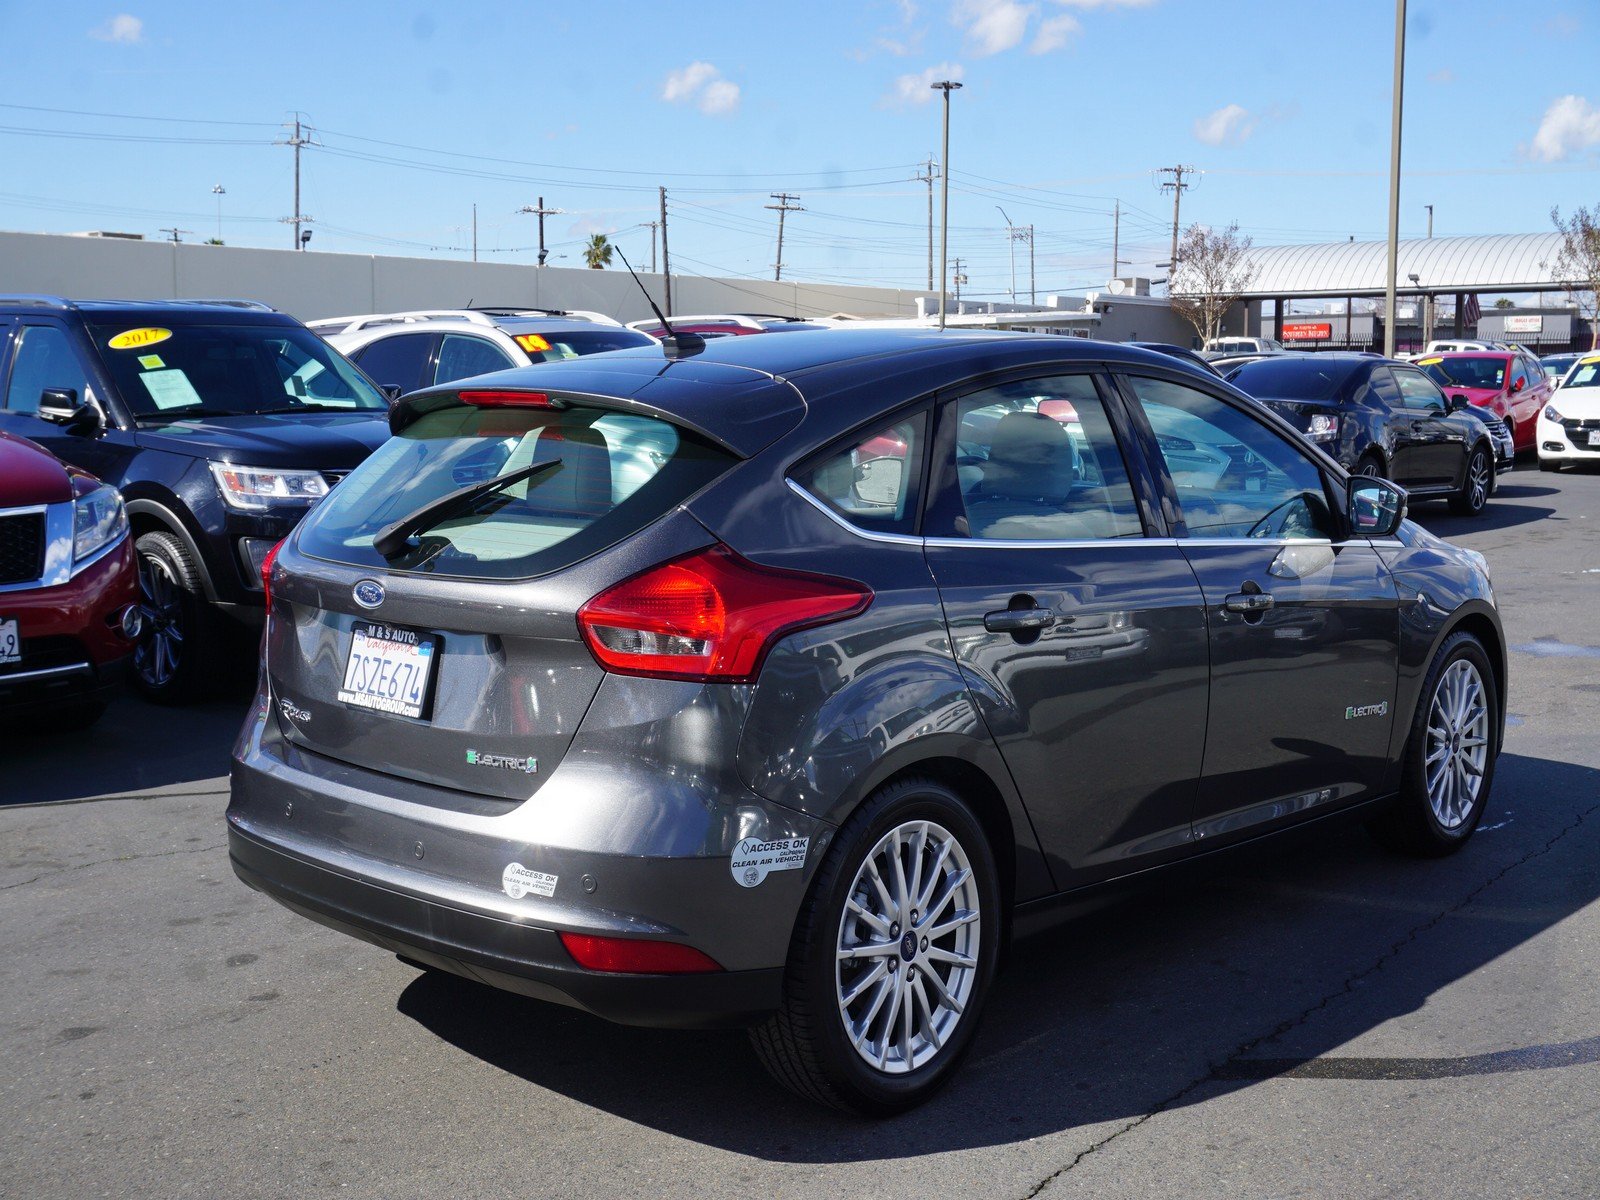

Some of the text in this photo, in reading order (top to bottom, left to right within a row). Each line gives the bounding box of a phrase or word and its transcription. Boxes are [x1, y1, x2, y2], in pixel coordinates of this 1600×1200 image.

[123, 329, 159, 347] 2017
[367, 625, 376, 638] M
[376, 626, 383, 638] &
[384, 628, 391, 639] S
[392, 629, 416, 644] AUTO
[366, 637, 418, 656] California
[350, 653, 420, 703] 7SZE674
[338, 690, 420, 718] www.MSAUTOGROUP.com
[1345, 703, 1384, 719] ELECTRIC
[466, 749, 527, 771] ELECTRIC
[749, 839, 808, 853] ACCESS OK
[732, 860, 758, 868] CLEAN
[775, 855, 805, 864] VEHICLE
[503, 876, 521, 884] CLEAN
[532, 883, 554, 892] VEHICLE
[515, 868, 557, 883] ACCESS OK
